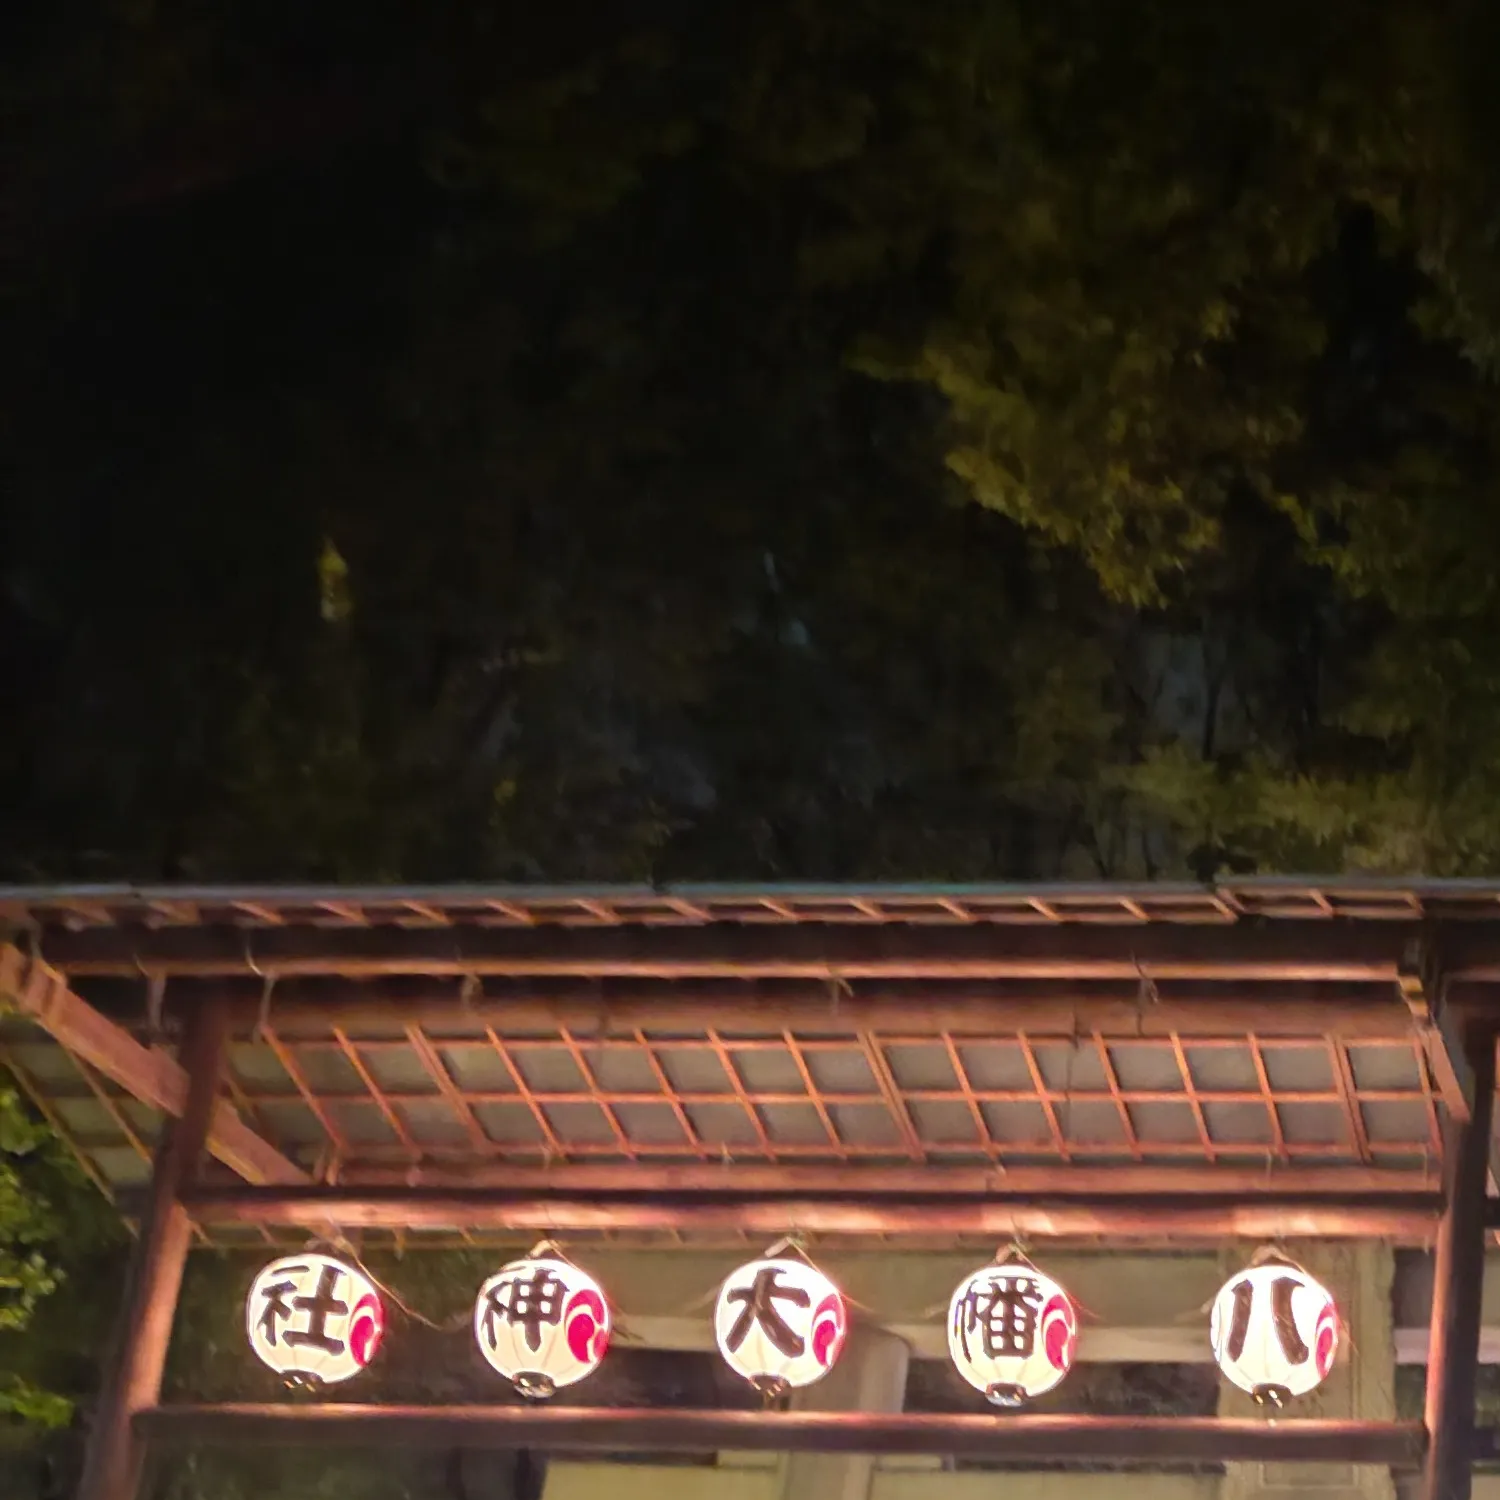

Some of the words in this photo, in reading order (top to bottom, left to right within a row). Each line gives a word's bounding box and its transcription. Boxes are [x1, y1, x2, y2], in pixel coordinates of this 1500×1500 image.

[257, 1263, 351, 1356] 社
[480, 1266, 570, 1353] 神
[724, 1267, 811, 1359] 大
[956, 1274, 1044, 1364] 幡
[1225, 1276, 1309, 1366] 八
